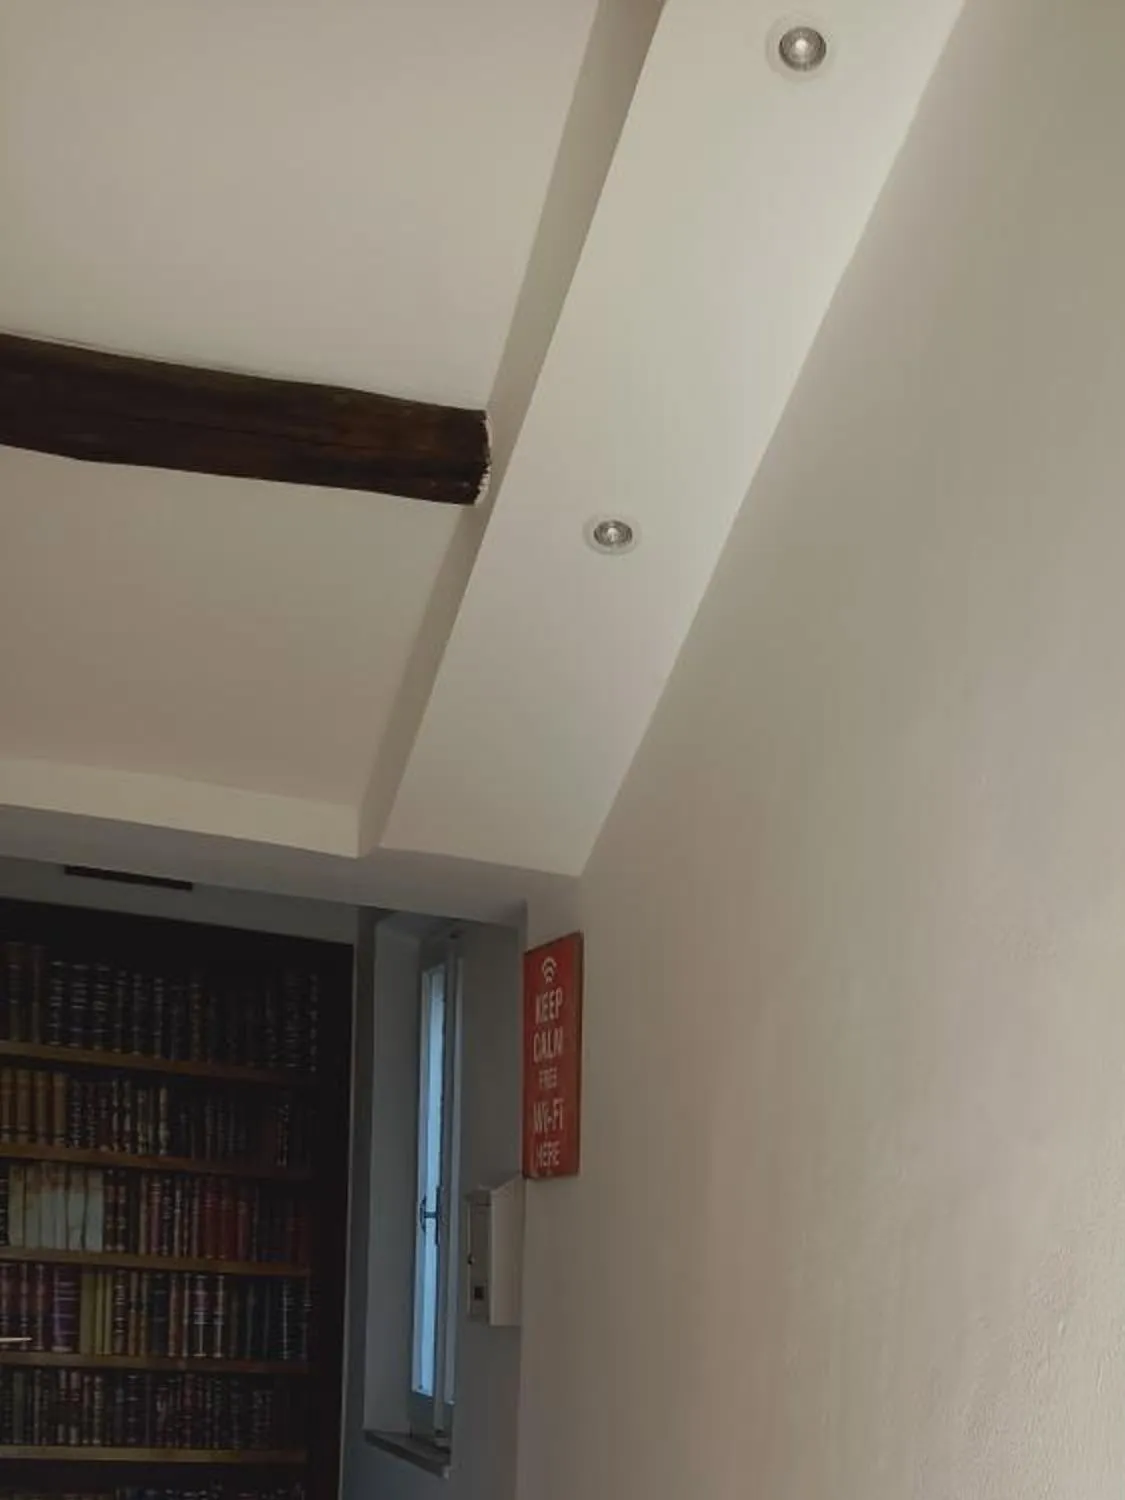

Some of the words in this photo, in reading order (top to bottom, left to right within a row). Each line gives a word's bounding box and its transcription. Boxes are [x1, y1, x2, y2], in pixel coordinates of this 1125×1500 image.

[535, 987, 564, 1025] KEEP
[533, 1027, 564, 1063] CALM
[536, 1141, 561, 1168] HERE
